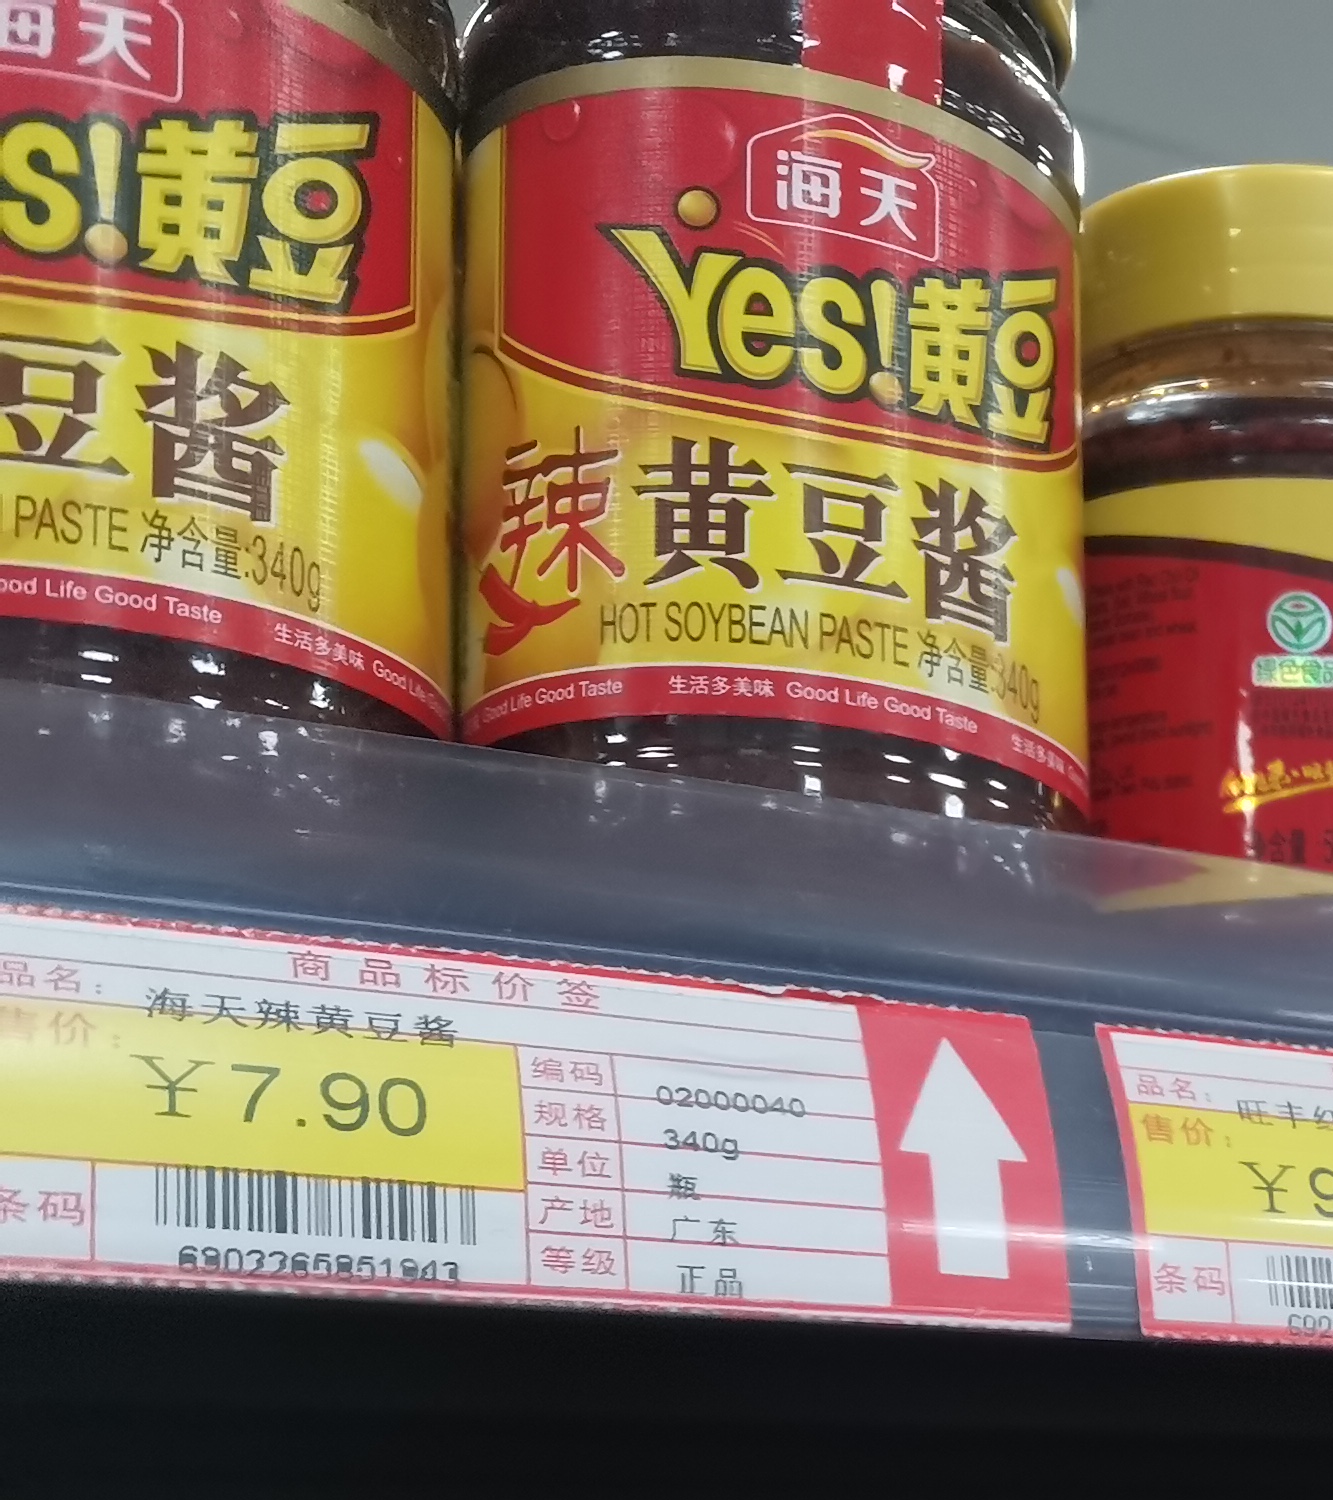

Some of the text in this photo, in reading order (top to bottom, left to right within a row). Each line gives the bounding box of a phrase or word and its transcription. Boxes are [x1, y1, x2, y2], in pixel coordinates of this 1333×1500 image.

[776, 149, 918, 241] 海天
[608, 226, 1058, 445] Yes!黄豆
[14, 494, 129, 553] PASTE
[46, 578, 87, 601] Life
[94, 584, 157, 612] Good
[163, 595, 222, 624] Taste
[601, 603, 656, 646] HOT
[666, 602, 809, 650] SOYBEAN
[820, 612, 910, 668] PASTE
[274, 621, 365, 672] 生活多美味
[372, 659, 406, 690] Good
[510, 691, 532, 713] Life
[535, 683, 575, 705] Good
[579, 677, 624, 699] Taste
[668, 675, 978, 734] 生活多美味 Good Life Good Taste
[286, 949, 600, 1009] 商品标价签
[145, 986, 458, 1048] 海天辣黄豆酱
[531, 1057, 604, 1086] 编码
[130, 1054, 427, 1137] ¥7.90
[656, 1085, 806, 1118] 02000040
[535, 1101, 606, 1132] 规格
[663, 1128, 740, 1160] 340g
[538, 1147, 612, 1180] 单位
[538, 1196, 614, 1230] 产地
[670, 1214, 738, 1245] 广东
[541, 1246, 617, 1277] 等级
[1153, 1262, 1226, 1297] 条码
[676, 1265, 744, 1298] 正品
